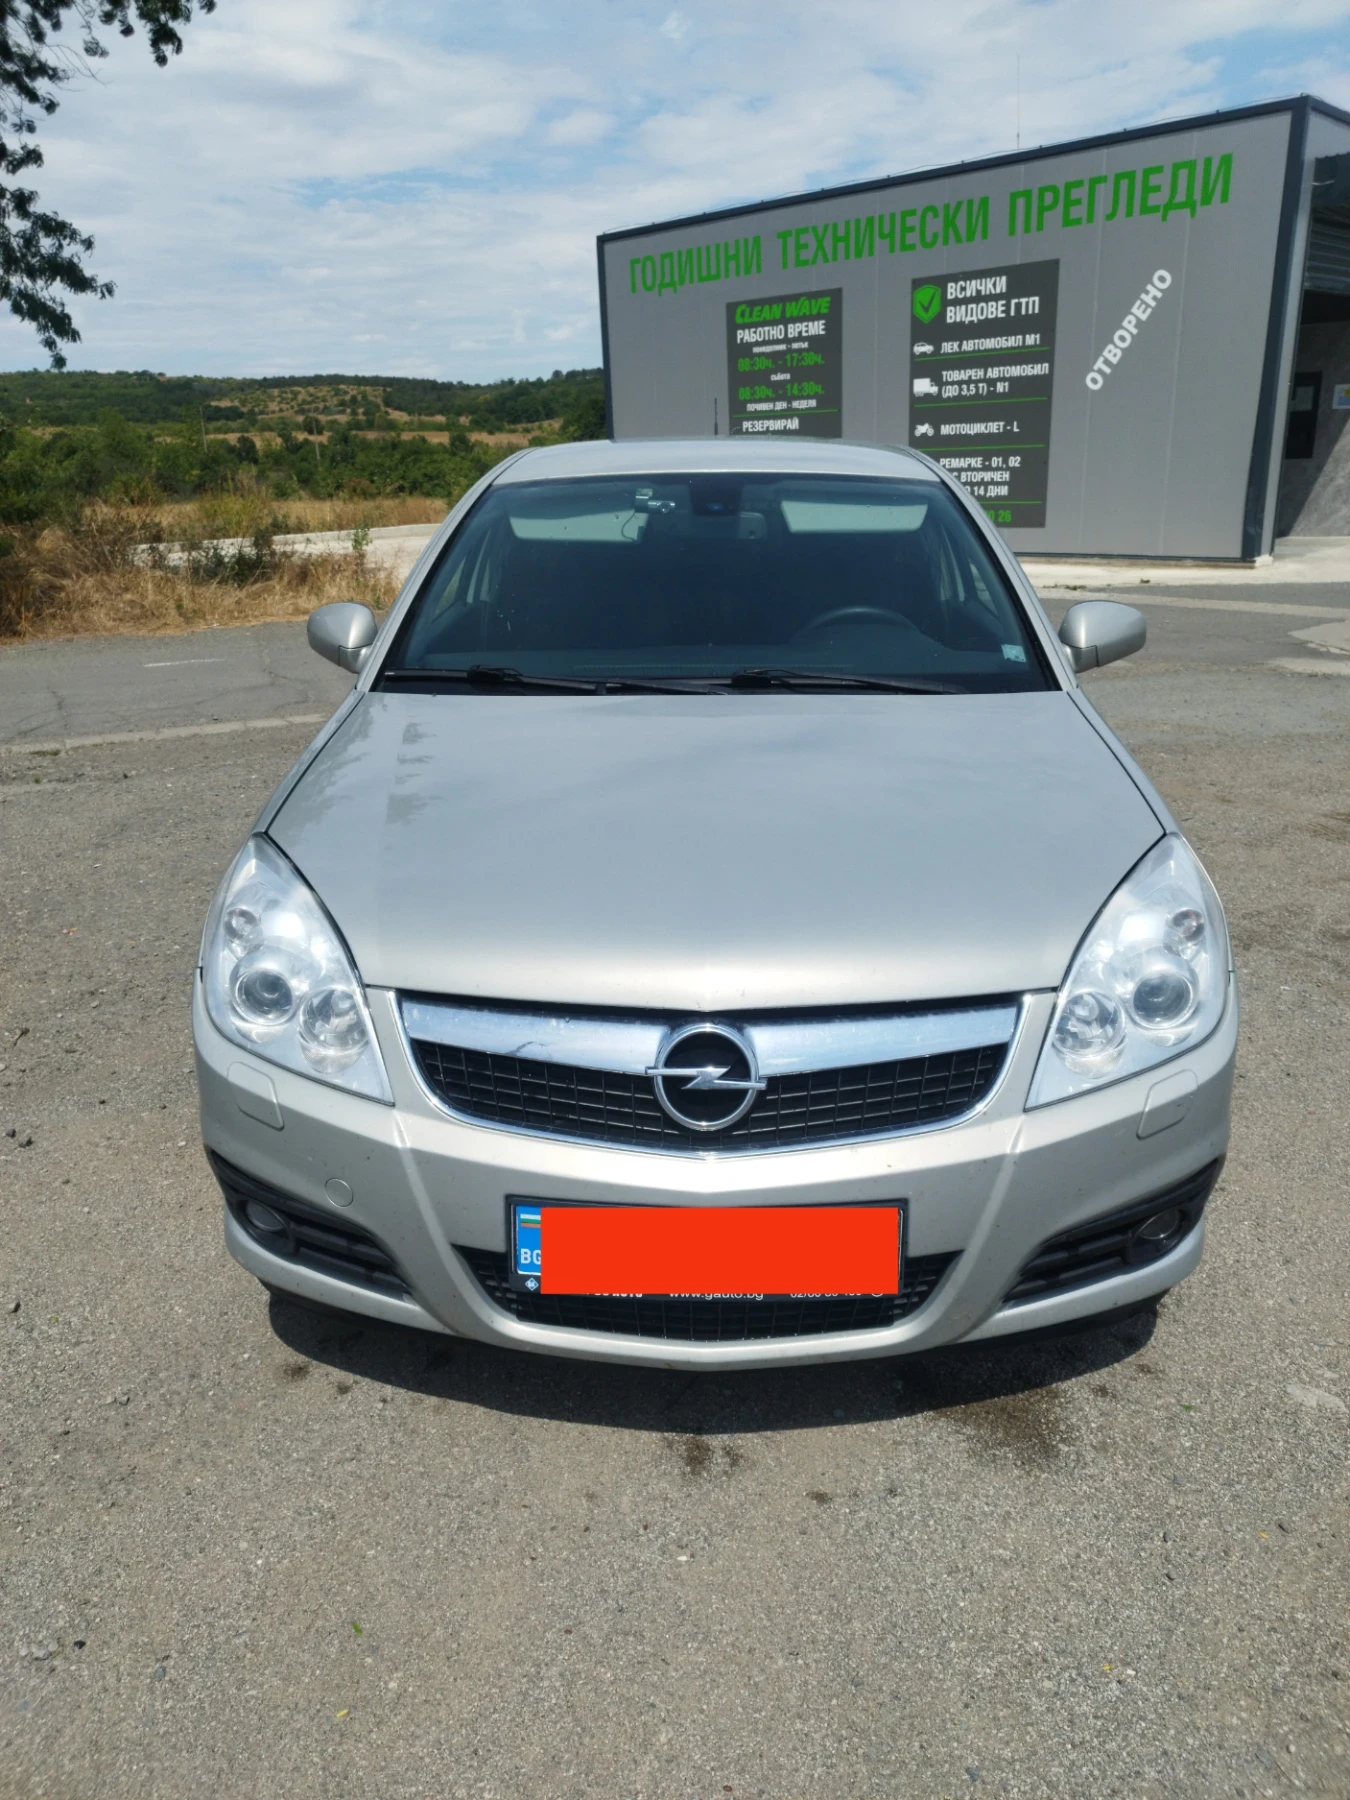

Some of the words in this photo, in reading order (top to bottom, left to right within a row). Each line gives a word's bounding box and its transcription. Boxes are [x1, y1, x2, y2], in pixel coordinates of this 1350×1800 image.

[629, 235, 762, 297] ГОДИШНИ
[777, 196, 990, 270] ТЕХНИЧЕСКИ
[1008, 153, 1233, 237] ПРЕГЛЕДИ
[946, 276, 1007, 300] ВСИЧКИ
[735, 303, 783, 324] CLEAN
[785, 296, 831, 318] WAVE
[946, 301, 1006, 324] ВИДОВЕ
[1010, 296, 1040, 317] ГТП
[737, 325, 785, 344] РАБОТНО
[787, 320, 826, 338] ВРЕМЕ
[1085, 269, 1172, 391] ОТВОРЕНО
[940, 341, 960, 354] ЛЕК
[961, 335, 1023, 352] АВТОМОБИЛ
[942, 370, 984, 382] ТОВАРЕН
[986, 363, 1049, 379] АВТОМОБИЛ
[941, 385, 960, 398] (ДО
[961, 384, 976, 396] 3,5
[996, 382, 1009, 393] N1
[774, 400, 788, 410] ДЕН
[742, 416, 799, 432] РЕЗЕРВИРАЙ
[940, 422, 1004, 435] МОТОЦИКЛЕТ
[1013, 421, 1020, 432] L
[939, 458, 983, 469] РЕМАРКЕ
[1008, 456, 1021, 467] 02
[960, 471, 1010, 482] ВТОРИЧЕН
[973, 485, 985, 496] 14
[986, 485, 1008, 498] ДНИ
[997, 510, 1012, 523] 26
[520, 1248, 541, 1265] BG
